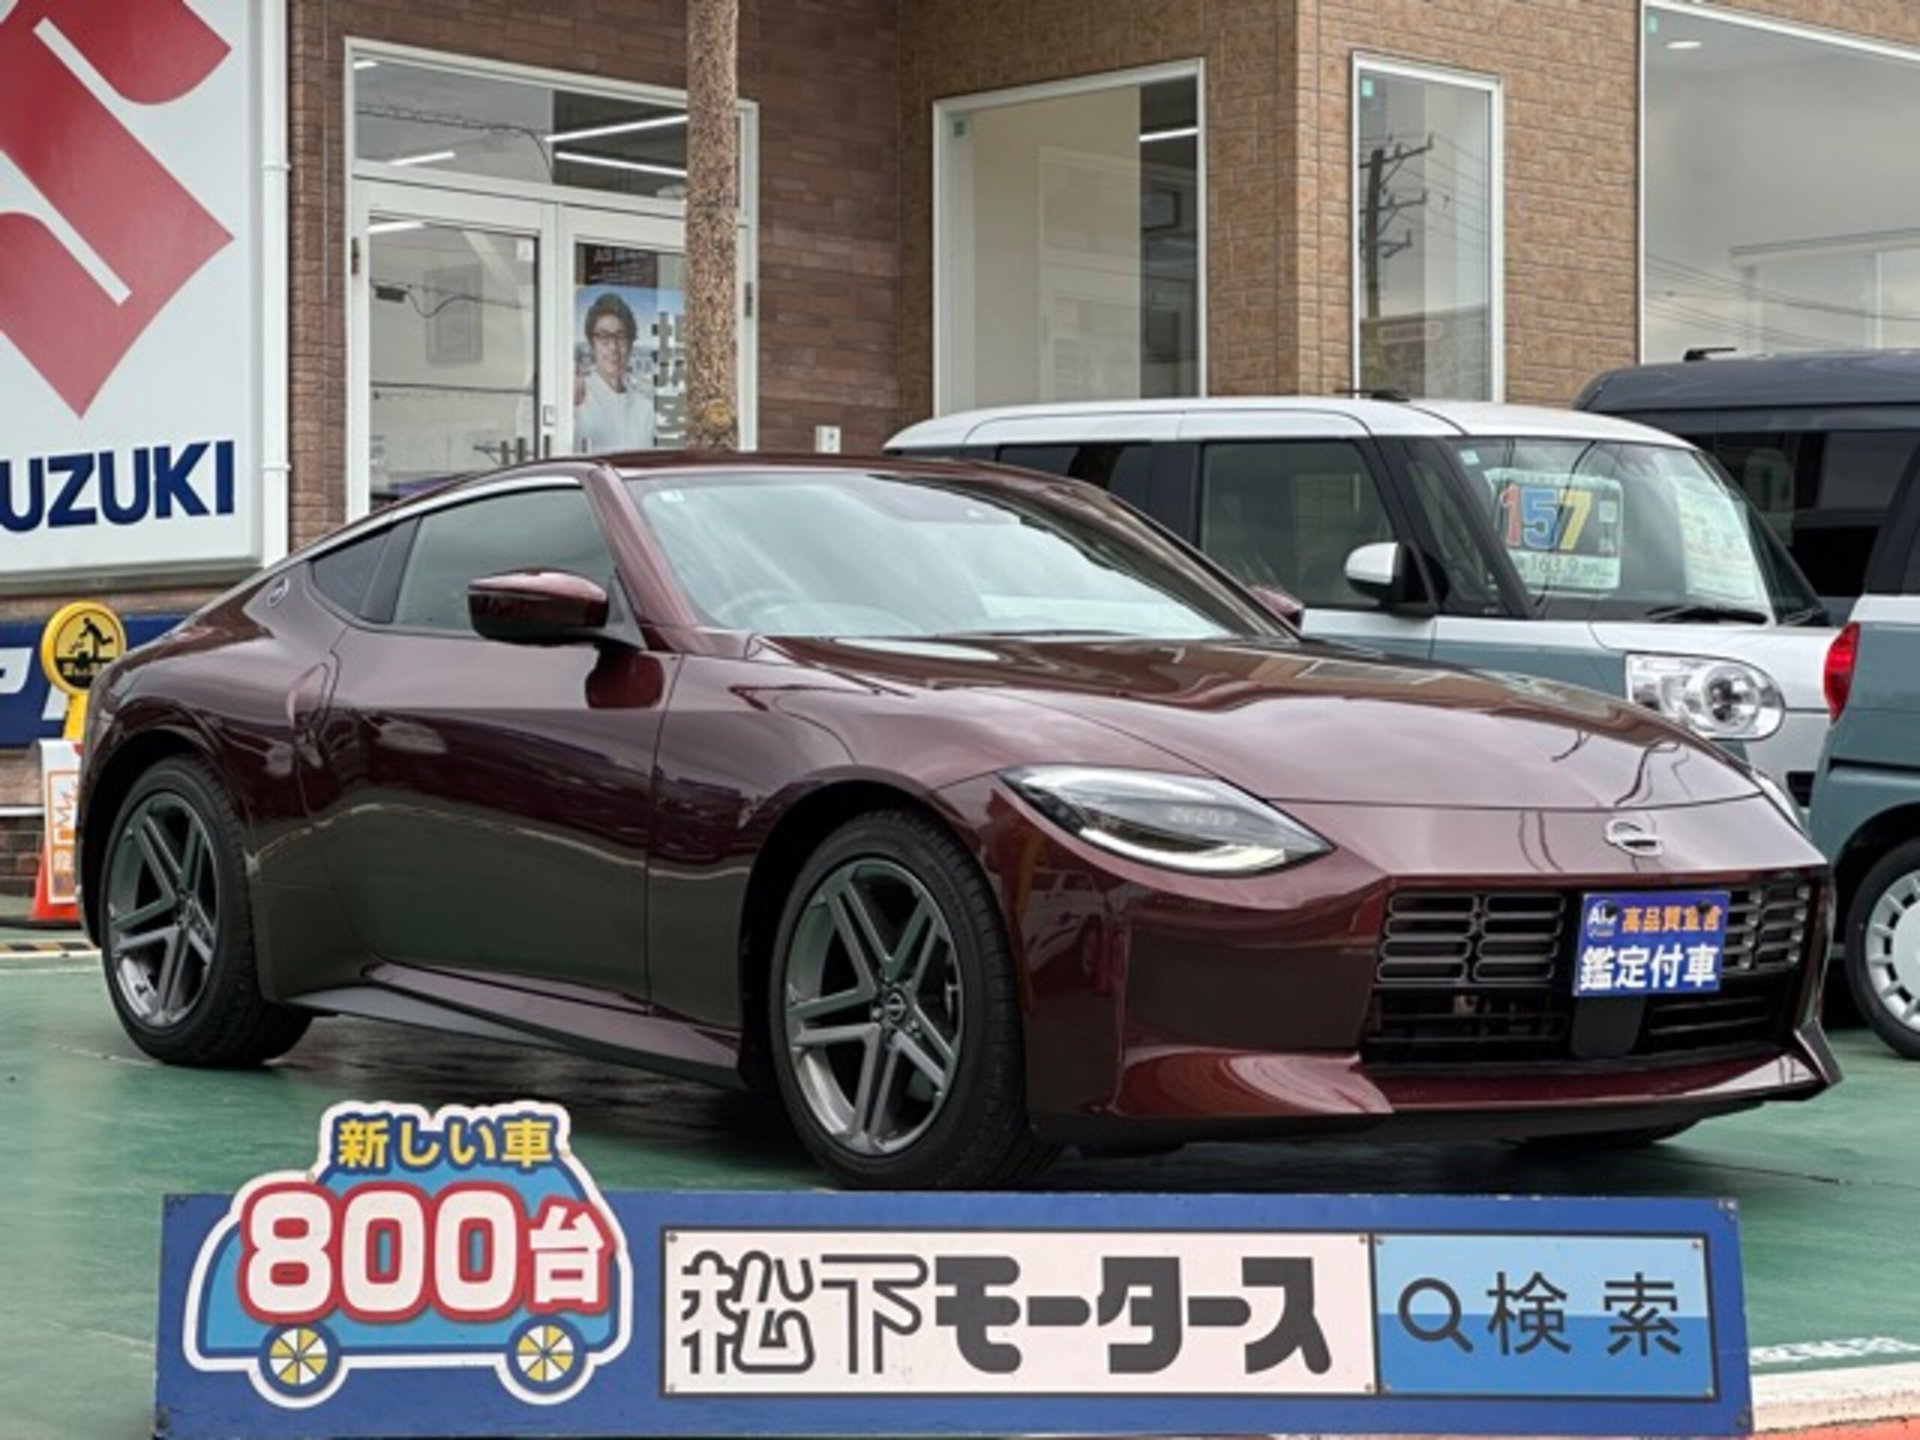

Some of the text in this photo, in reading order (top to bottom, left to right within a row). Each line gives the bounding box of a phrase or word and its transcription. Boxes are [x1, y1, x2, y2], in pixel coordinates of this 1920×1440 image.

[0, 440, 234, 532] UZUKI
[1499, 483, 1592, 551] 157
[1580, 943, 1719, 990] 鑑定付車
[338, 1117, 551, 1169] 新しい車
[247, 1189, 604, 1313] 800台
[681, 1250, 1332, 1374] 松下モータース
[1487, 1271, 1682, 1356] 検索
